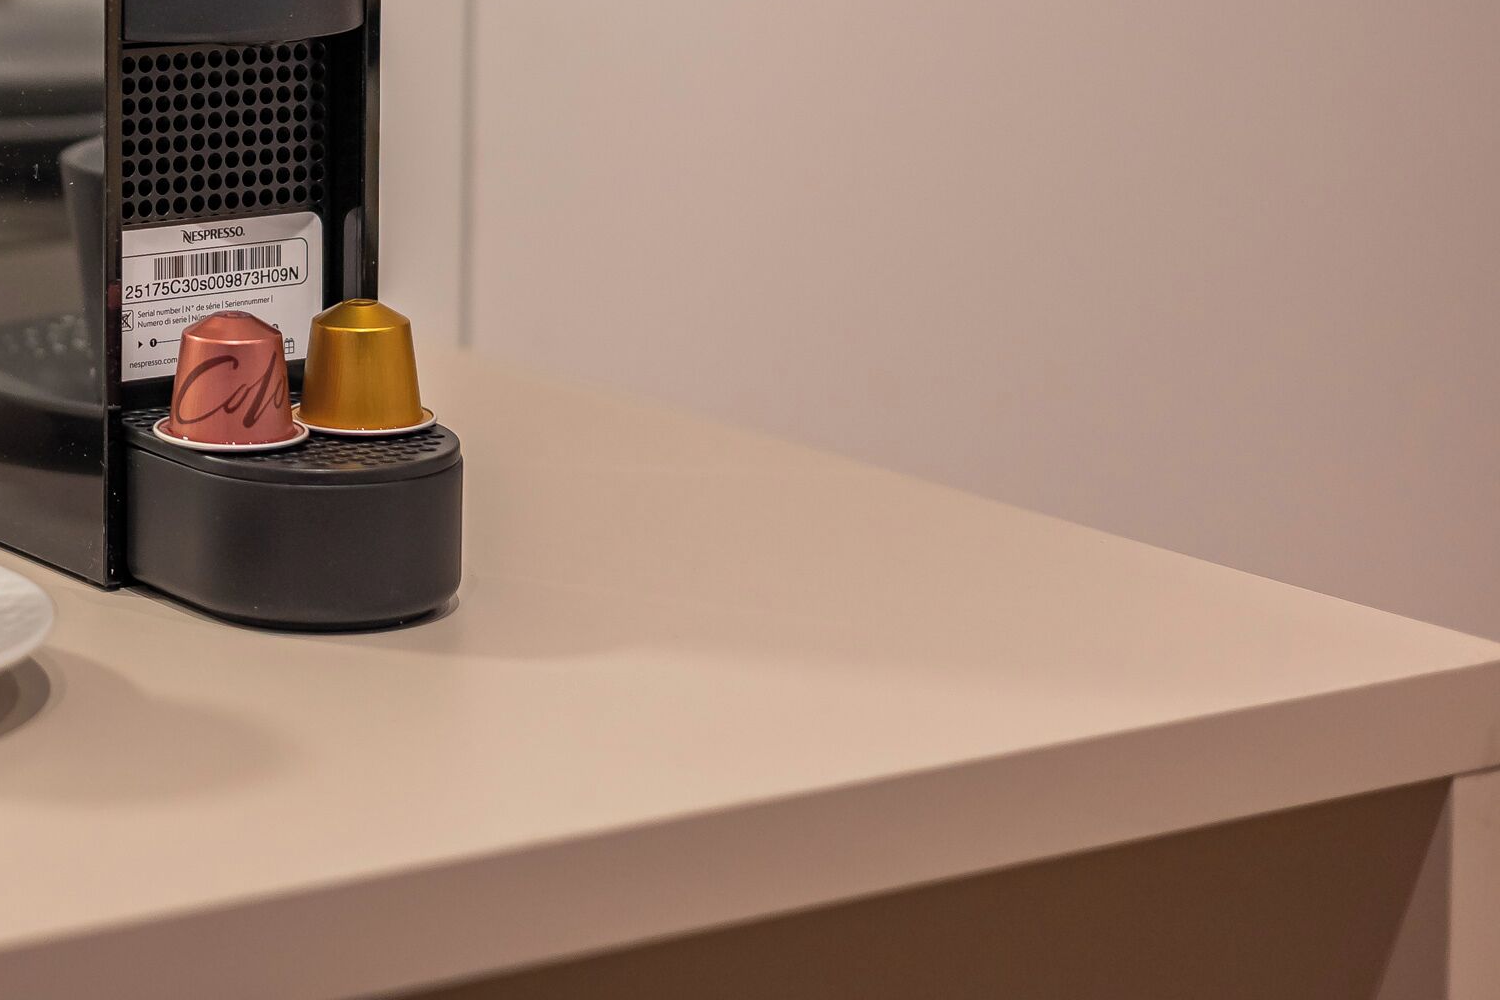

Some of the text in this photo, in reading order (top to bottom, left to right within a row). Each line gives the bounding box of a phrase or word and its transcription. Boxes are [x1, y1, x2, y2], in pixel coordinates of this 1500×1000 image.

[181, 226, 244, 244] NESPRESSO
[125, 266, 299, 300] 25175C30s009873H09N
[137, 309, 156, 319] Serial
[156, 307, 181, 316] number
[196, 303, 205, 311] de
[206, 301, 221, 310] série
[225, 297, 270, 308] Seriennummer
[137, 319, 164, 328] Numero
[164, 317, 172, 325] di
[172, 316, 188, 324] serie
[129, 357, 178, 369] nespresso.com
